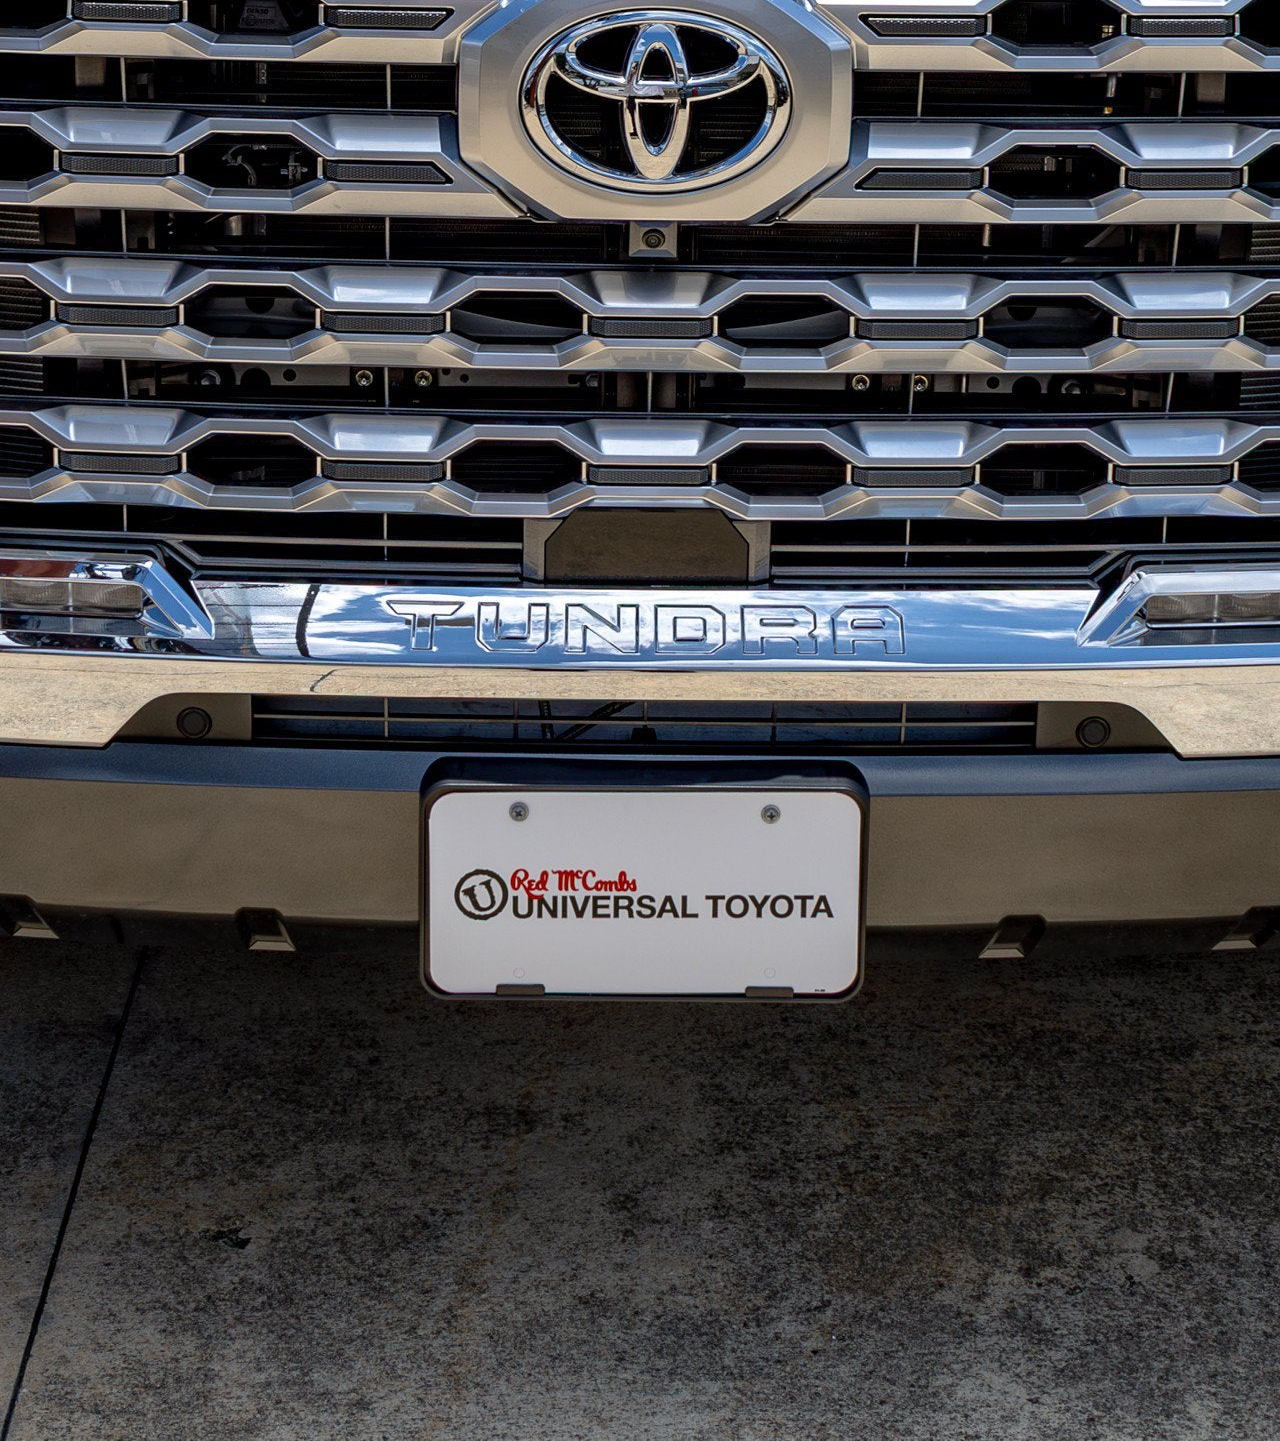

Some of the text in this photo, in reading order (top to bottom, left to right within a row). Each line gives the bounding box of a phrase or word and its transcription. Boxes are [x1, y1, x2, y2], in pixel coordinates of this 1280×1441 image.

[385, 599, 907, 656] TUNDRA
[510, 868, 637, 900] Red McCombs
[512, 894, 835, 919] UNIVERSAL TOYOTA
